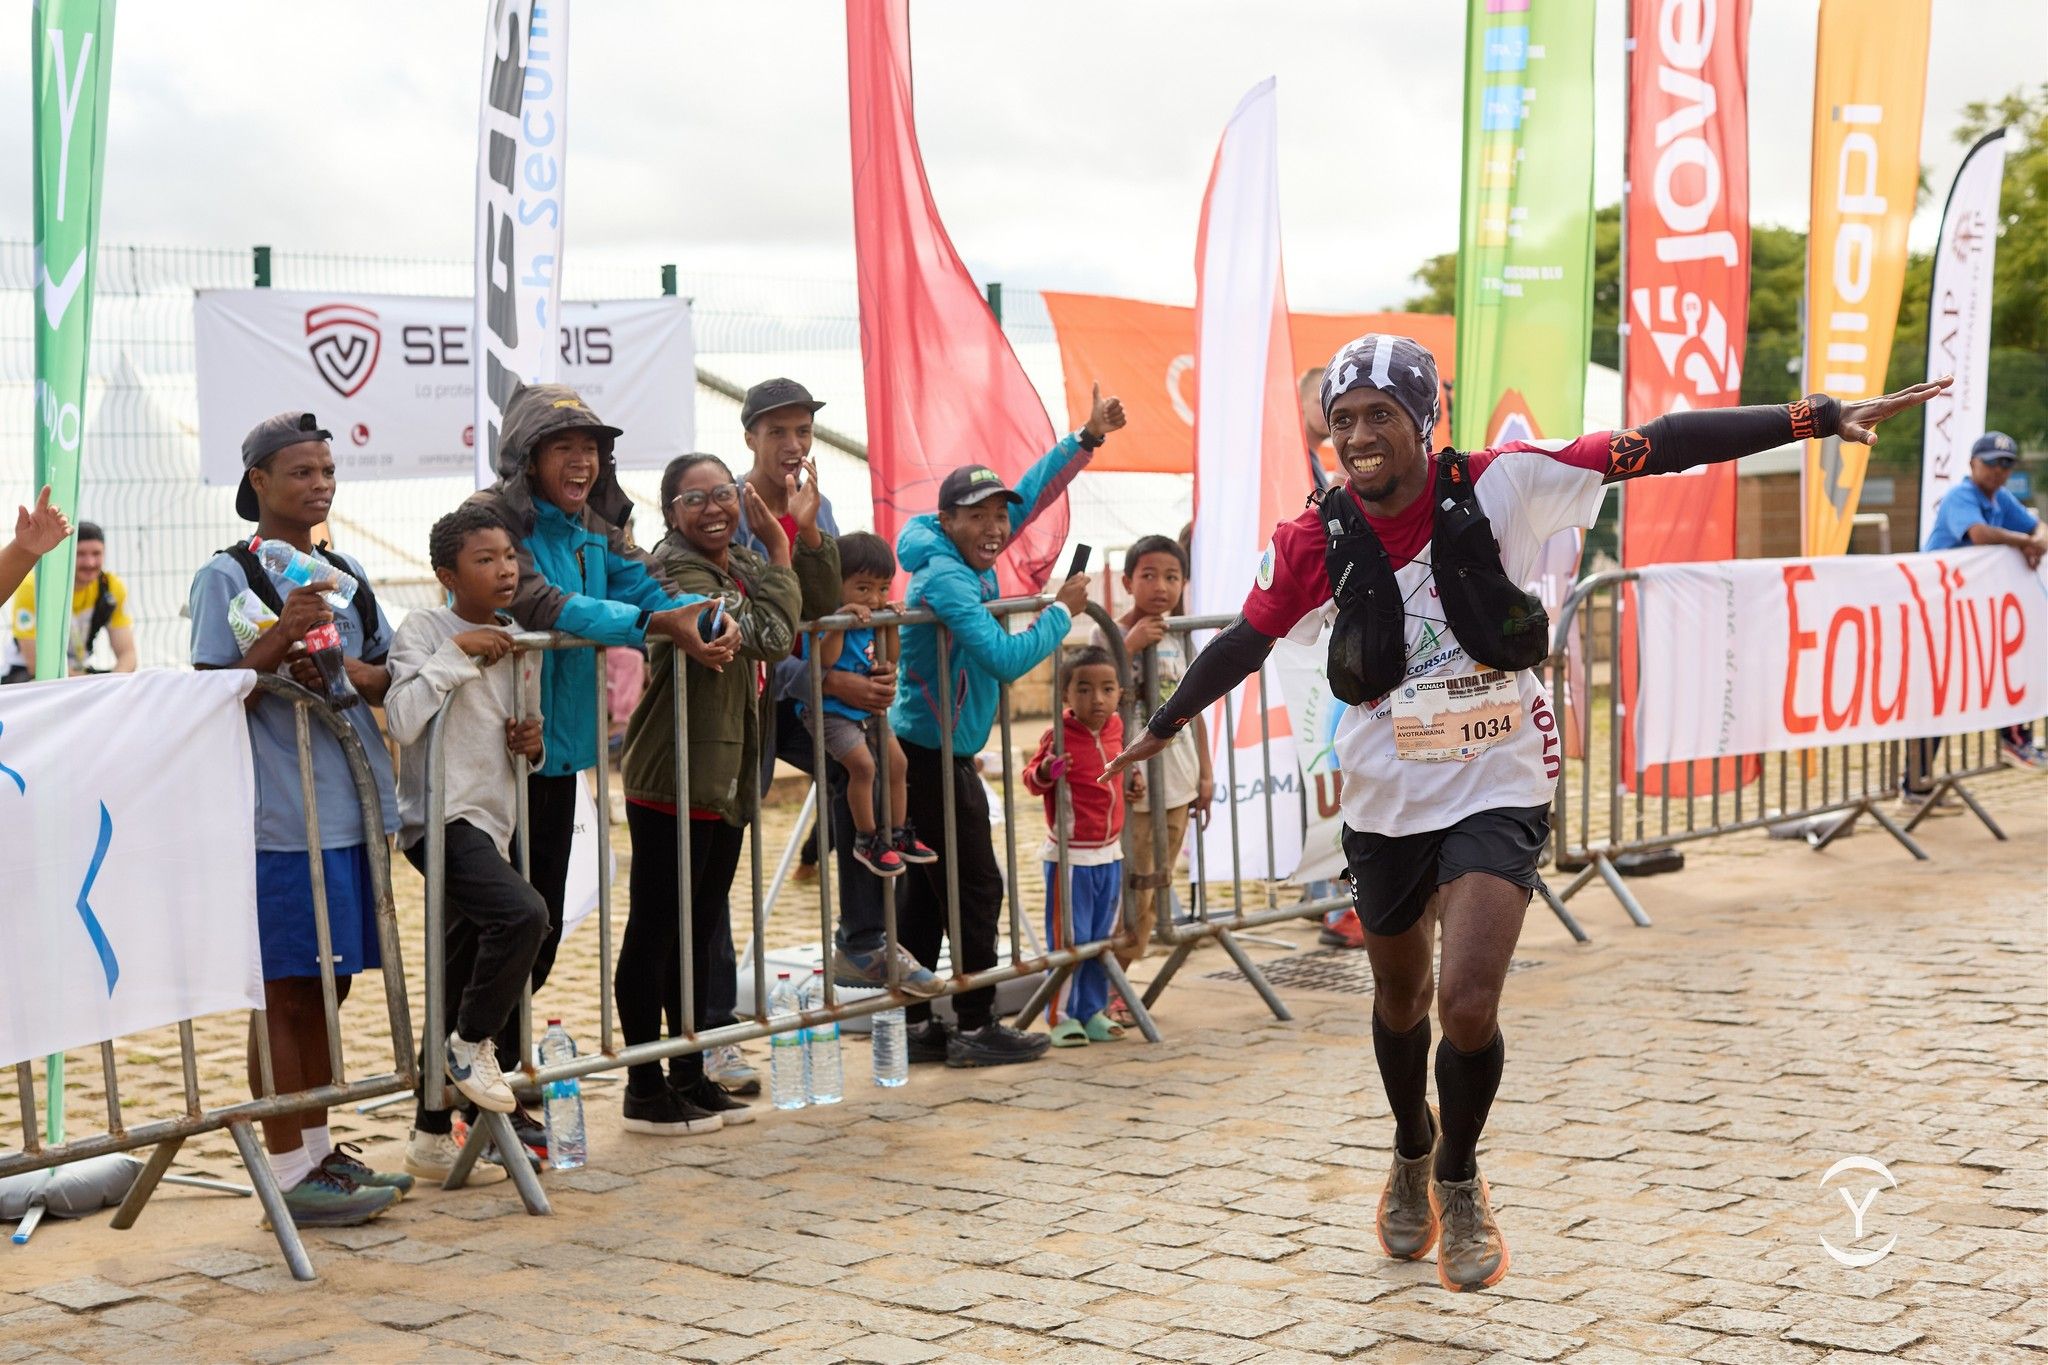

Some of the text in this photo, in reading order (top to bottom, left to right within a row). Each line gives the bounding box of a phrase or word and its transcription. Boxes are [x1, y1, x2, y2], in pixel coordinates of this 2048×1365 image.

[1334, 561, 1355, 598] SALOMON
[1406, 647, 1461, 676] CORSAIR
[1417, 682, 1445, 690] CANAL+
[1446, 674, 1478, 690] ULTRA
[1480, 670, 1507, 684] TRAIL
[1304, 685, 1320, 744] Ultra
[1460, 714, 1512, 742] 1034
